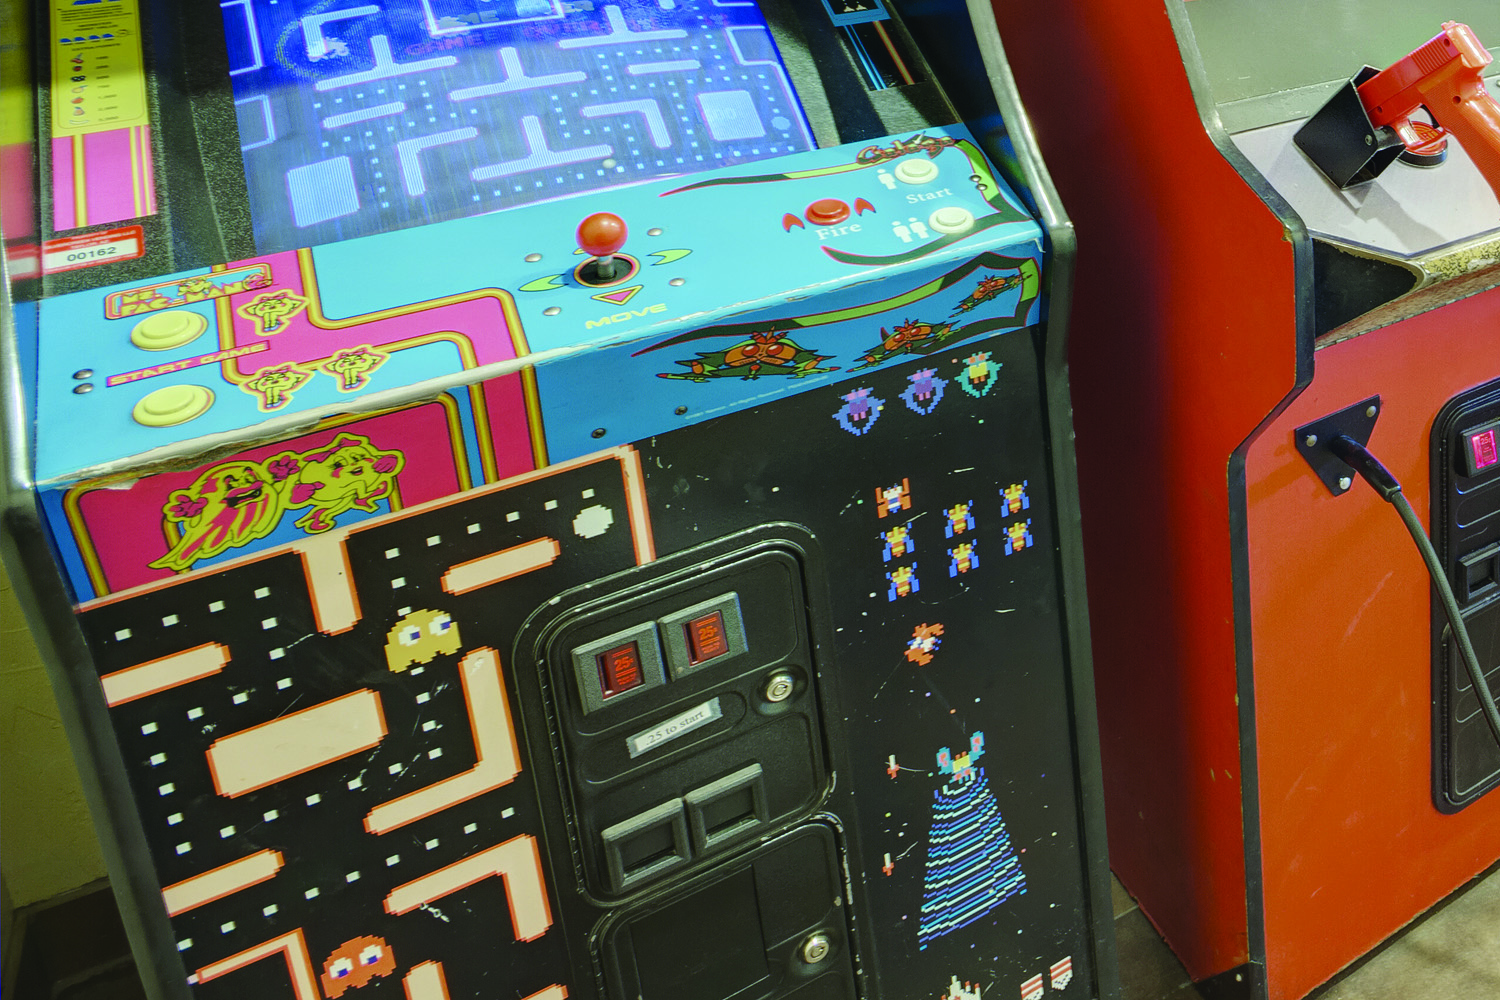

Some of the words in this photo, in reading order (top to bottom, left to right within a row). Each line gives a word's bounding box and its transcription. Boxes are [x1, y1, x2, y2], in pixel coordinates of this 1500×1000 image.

[856, 135, 956, 165] Galaga
[905, 187, 953, 204] Start
[814, 223, 863, 241] Fire
[66, 246, 117, 262] 00162
[585, 302, 668, 330] MOVE
[109, 360, 193, 386] START
[200, 343, 267, 365] GAME
[665, 724, 678, 736] to
[679, 710, 705, 729] start
